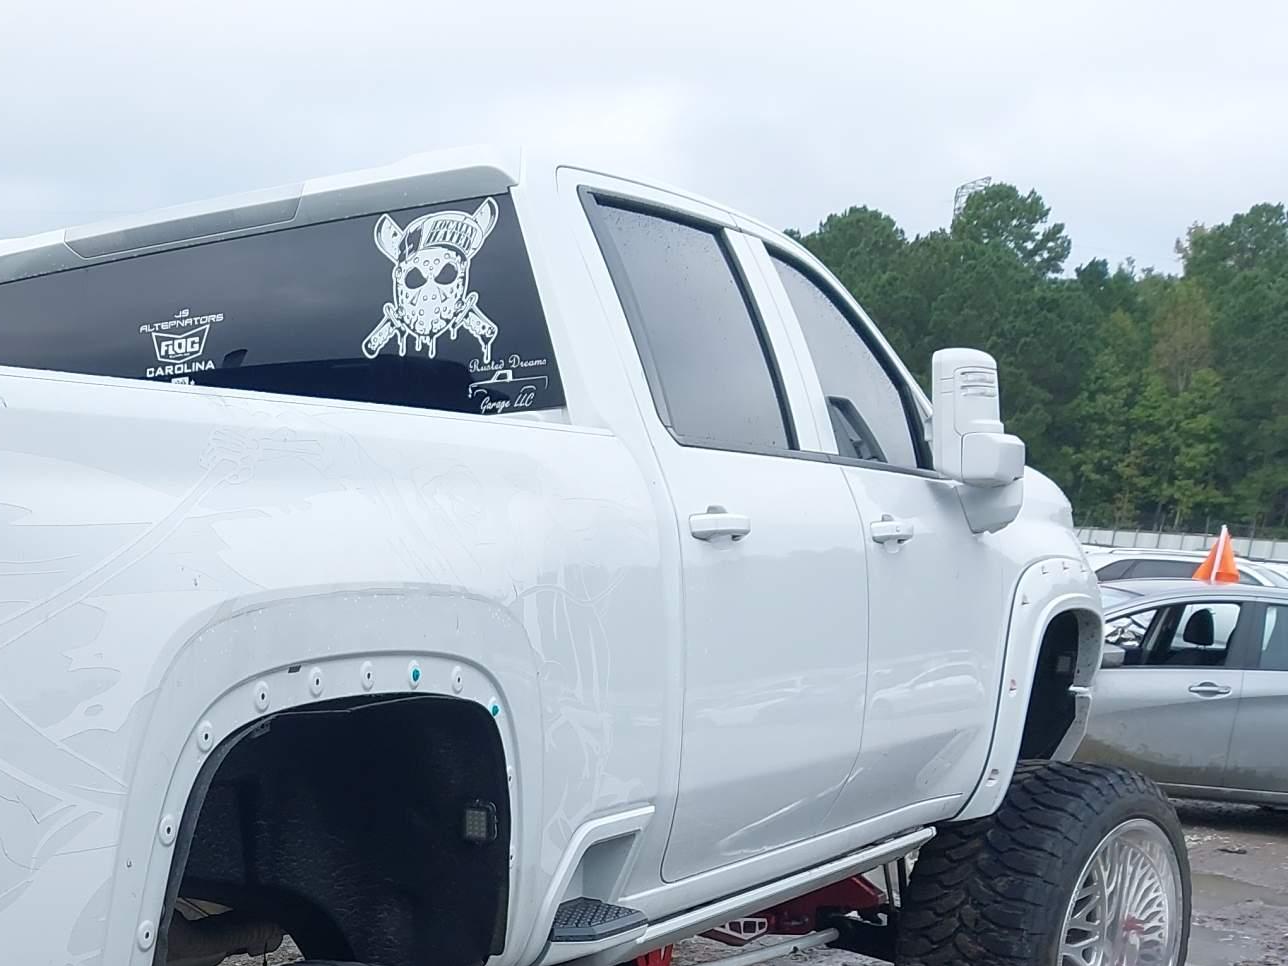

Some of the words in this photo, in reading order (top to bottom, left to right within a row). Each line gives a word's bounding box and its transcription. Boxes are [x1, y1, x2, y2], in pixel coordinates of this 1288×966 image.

[146, 360, 215, 378] CAROLINA
[469, 358, 505, 373] Rusted
[508, 354, 547, 369] Dreams
[480, 396, 511, 414] Garage
[513, 392, 535, 408] LLC
